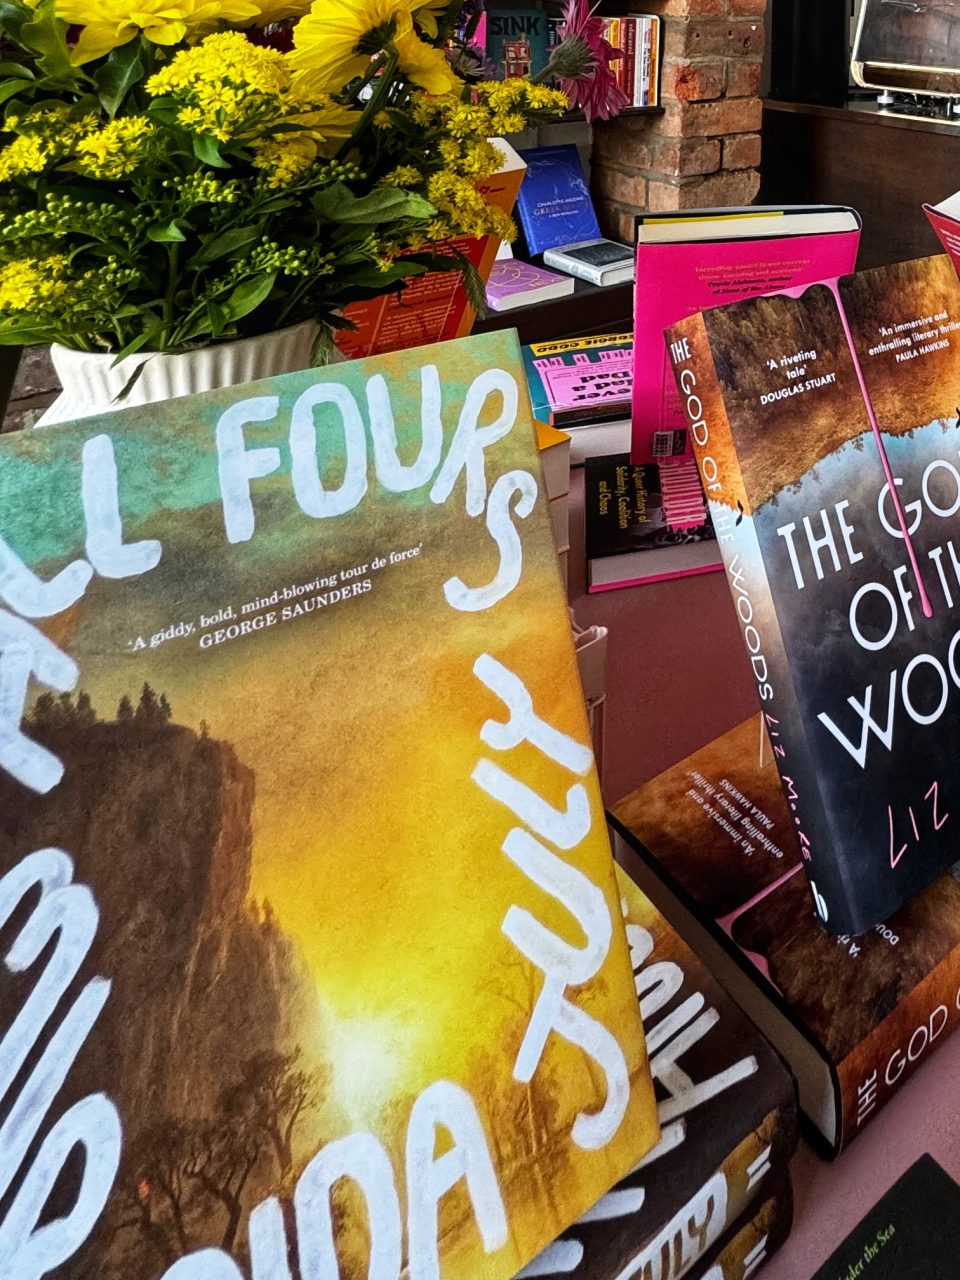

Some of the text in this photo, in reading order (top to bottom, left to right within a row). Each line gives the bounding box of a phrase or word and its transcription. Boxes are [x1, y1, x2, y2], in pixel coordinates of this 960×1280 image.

[489, 15, 540, 36] SINK
[583, 334, 634, 346] EORGIE
[878, 309, 949, 339] 'An immersive and
[669, 336, 692, 365] THE
[868, 336, 912, 357] enthralling
[912, 328, 939, 347] literary
[895, 339, 950, 363] PAULA HAWKINS
[766, 349, 817, 371] 'A riveting
[786, 366, 808, 380] tale'
[579, 371, 631, 384] Dad
[760, 372, 837, 405] DOUGLAS STUART
[572, 388, 631, 402] ever
[680, 369, 710, 447] GOD
[215, 364, 538, 612] FOURS
[632, 471, 646, 490] Queer
[702, 456, 723, 493] OF
[599, 480, 612, 516] and Chaos
[614, 465, 632, 529] Solidarity, Coalition
[634, 490, 649, 515] History
[638, 515, 651, 523] of
[777, 500, 864, 590] THE
[127, 540, 424, 653] 'A giddy, bold, mind-blowing tour de force'
[848, 563, 917, 651] OF
[198, 578, 374, 650] GEORGE SAUNDERS
[727, 552, 775, 702] WOODS
[765, 715, 785, 758] LIZ
[887, 780, 949, 869] LIZ
[472, 652, 629, 1150] JULY
[863, 1223, 896, 1264] the Sea
